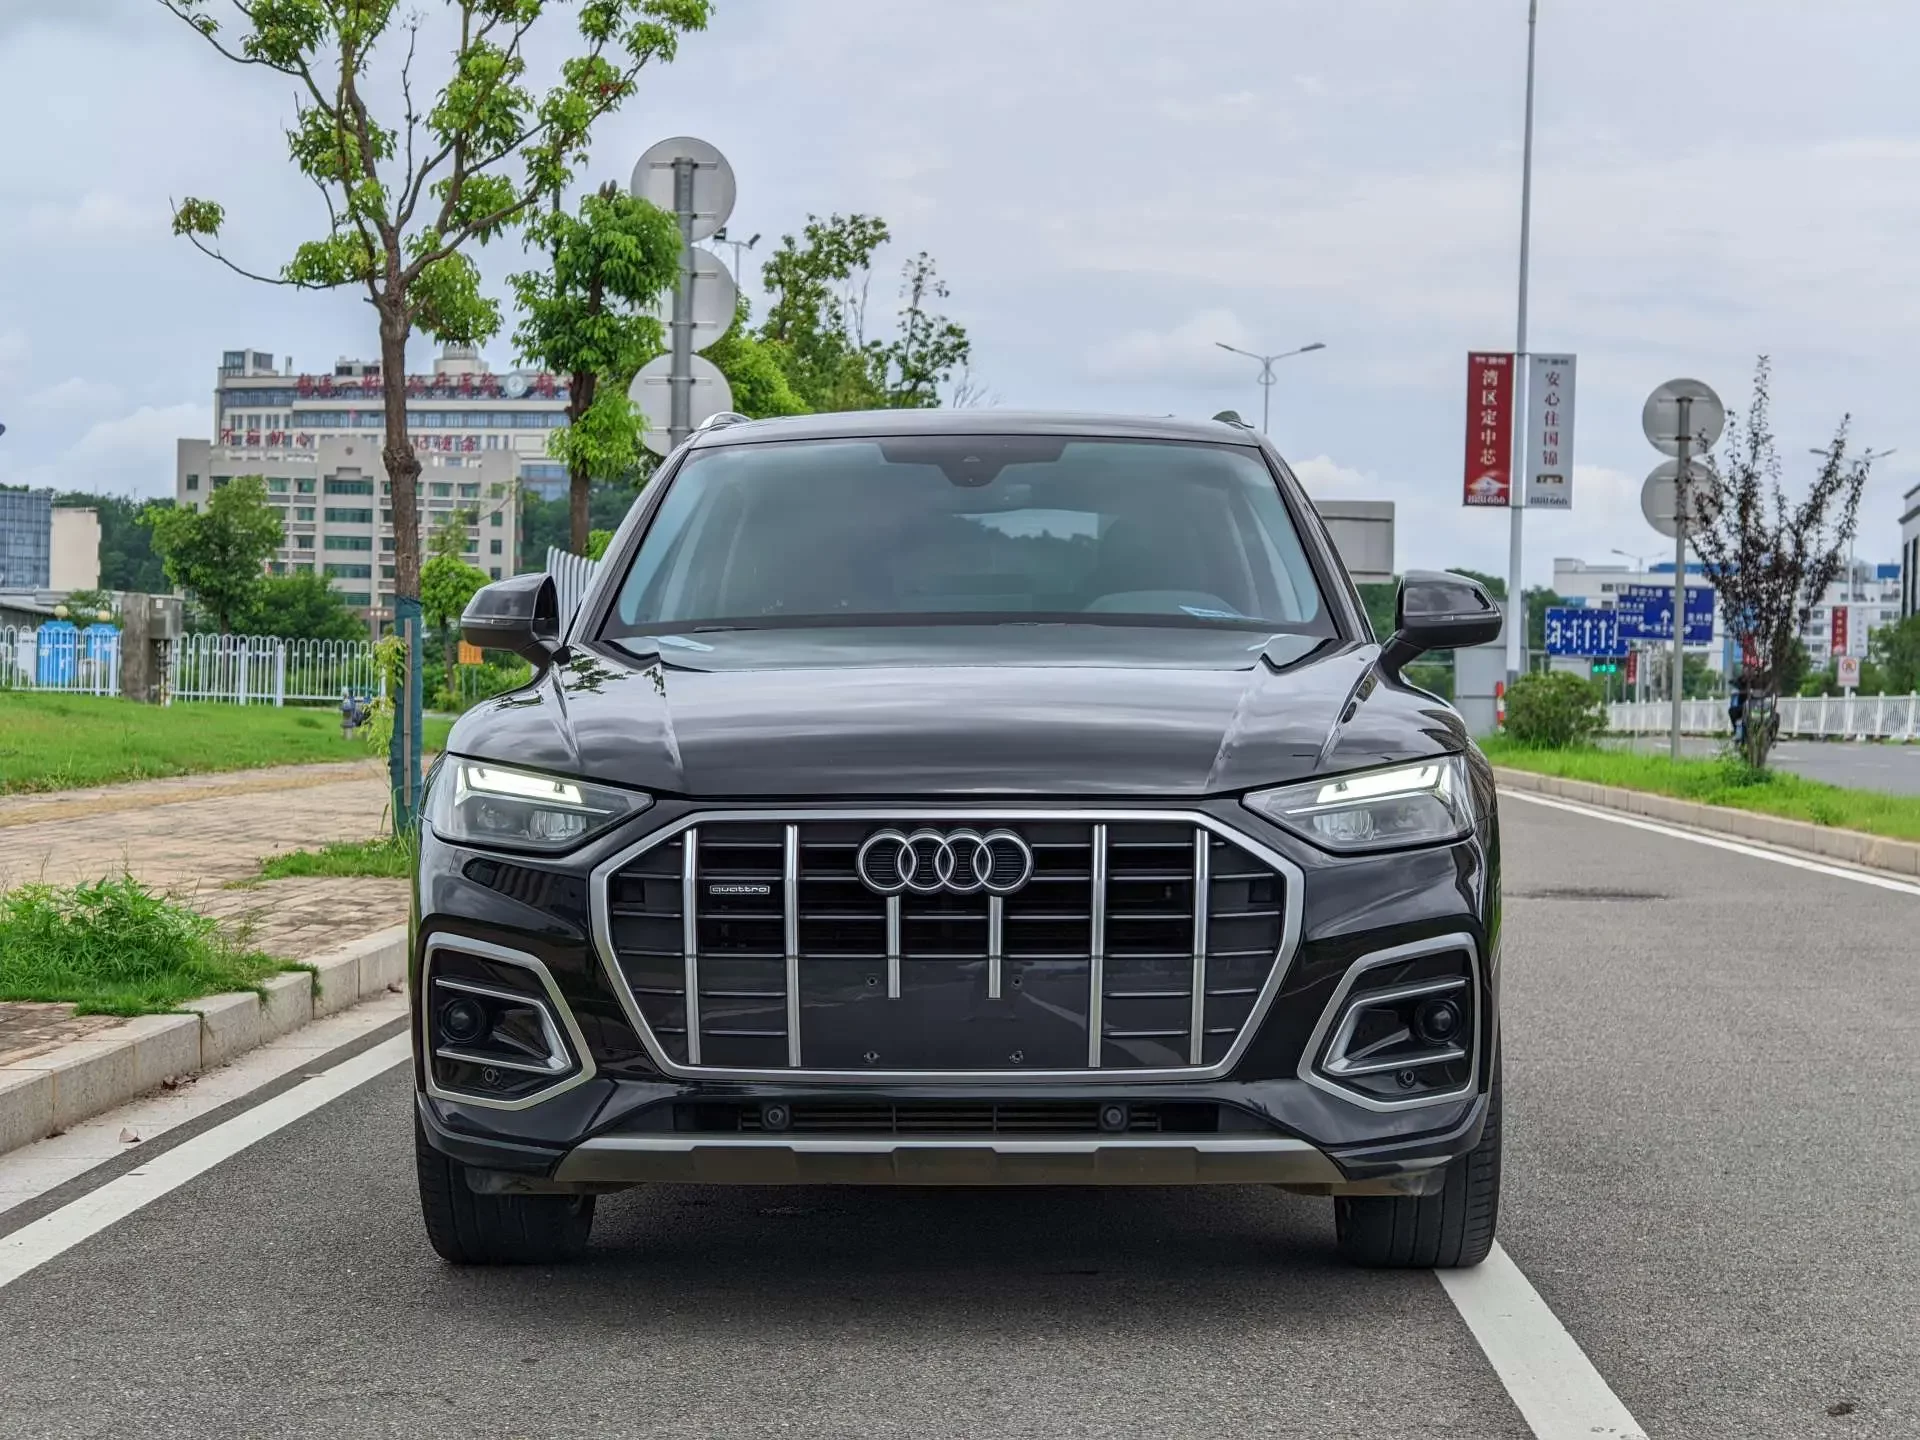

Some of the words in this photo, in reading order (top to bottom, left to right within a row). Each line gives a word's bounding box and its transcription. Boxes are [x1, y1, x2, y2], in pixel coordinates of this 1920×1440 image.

[413, 434, 475, 452] 记使命
[1480, 369, 1498, 465] 湾区定中芯
